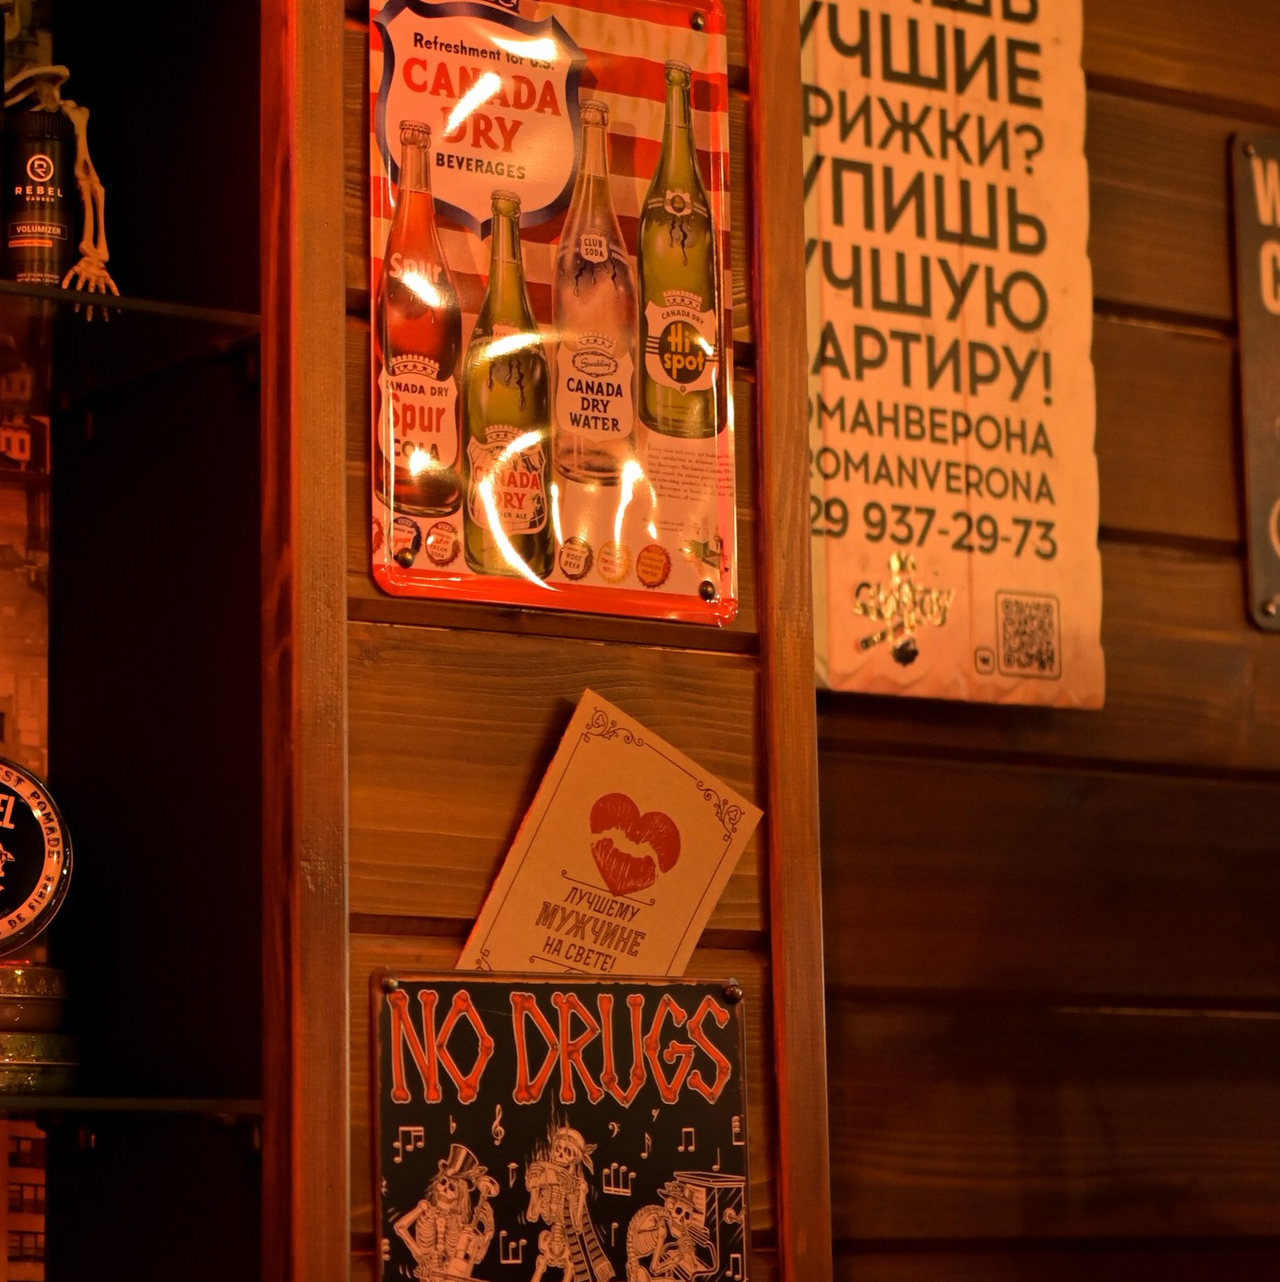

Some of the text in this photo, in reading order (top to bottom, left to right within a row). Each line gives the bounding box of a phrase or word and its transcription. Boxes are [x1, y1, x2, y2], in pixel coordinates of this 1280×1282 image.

[414, 32, 501, 61] Refreshment
[436, 152, 526, 180] BEVERAGES
[15, 185, 63, 198] REBEL
[16, 225, 61, 235] VOLUMIZER
[584, 238, 603, 248] CLUB
[585, 248, 605, 258] SODA
[805, 237, 1049, 333] ЧШУЮ
[661, 309, 704, 325] CANADA DRY
[667, 322, 690, 353] Hi
[663, 351, 705, 380] spot
[430, 386, 449, 397] DRY
[567, 377, 624, 398] CANADA
[581, 397, 610, 413] DRY
[569, 412, 621, 432] WATER
[808, 392, 1055, 458] МАНВЕРОНА
[809, 446, 1056, 506] OMANVERONA
[863, 501, 1058, 561] 937-29-73
[566, 552, 583, 562] ROOT
[563, 886, 641, 922] ЛУЧШЕМУ
[8, 913, 27, 930] DE
[535, 901, 647, 958] МУЖЧИНЕ
[542, 937, 616, 974] НА СВЕТЕ!
[387, 988, 732, 1108] NO DRUGS
